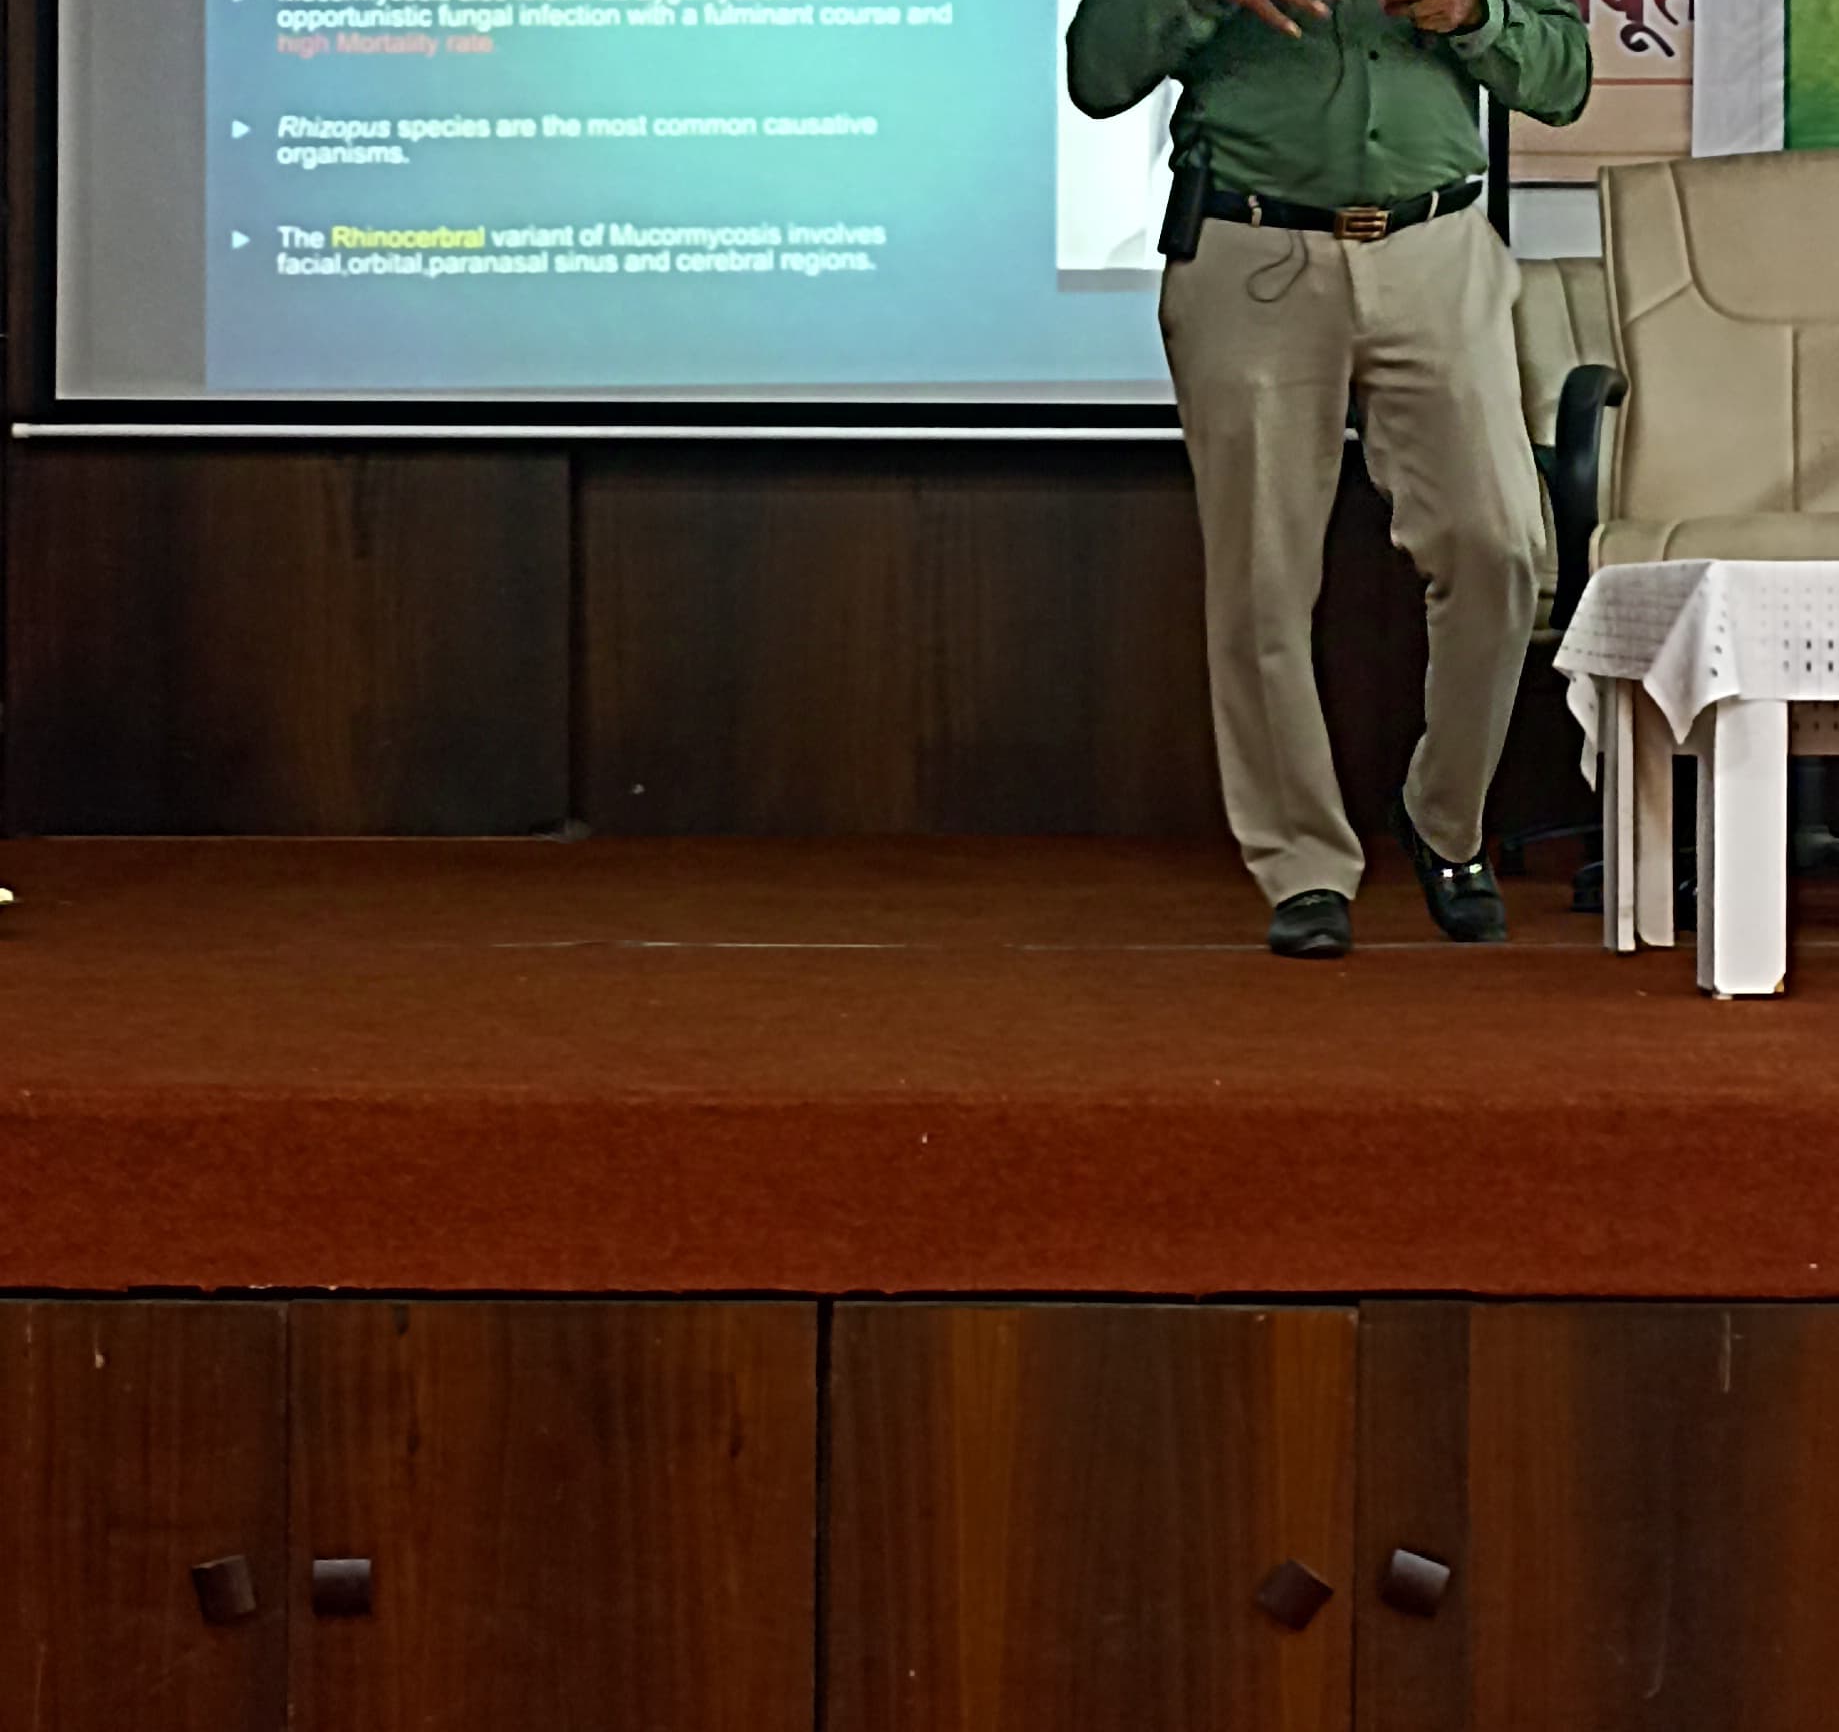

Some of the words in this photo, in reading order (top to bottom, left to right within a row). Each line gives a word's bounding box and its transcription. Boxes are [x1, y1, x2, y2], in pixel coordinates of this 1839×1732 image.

[277, 4, 433, 32] opportunistic
[438, 4, 513, 32] fungal
[519, 4, 621, 27] infection
[626, 4, 676, 26] with
[681, 8, 699, 26] a
[704, 3, 814, 25] fulminant
[819, 7, 901, 25] course
[907, 3, 953, 25] and
[277, 33, 330, 60] high
[336, 33, 438, 59] Mortality
[278, 116, 392, 142] Rhizopus
[397, 115, 491, 142] species
[496, 119, 537, 138] are
[542, 115, 581, 137] the
[587, 116, 647, 137] most
[653, 118, 757, 136] common
[763, 114, 878, 136] causative
[277, 143, 410, 170] organisms.
[277, 226, 325, 249] The
[491, 225, 574, 248] variant
[578, 224, 604, 247] of
[609, 223, 782, 249] Mucormycosis
[788, 223, 886, 245] involves
[554, 251, 619, 273] sinus
[623, 251, 670, 273] and
[675, 249, 774, 272] cerebral
[780, 250, 876, 276] regions.
